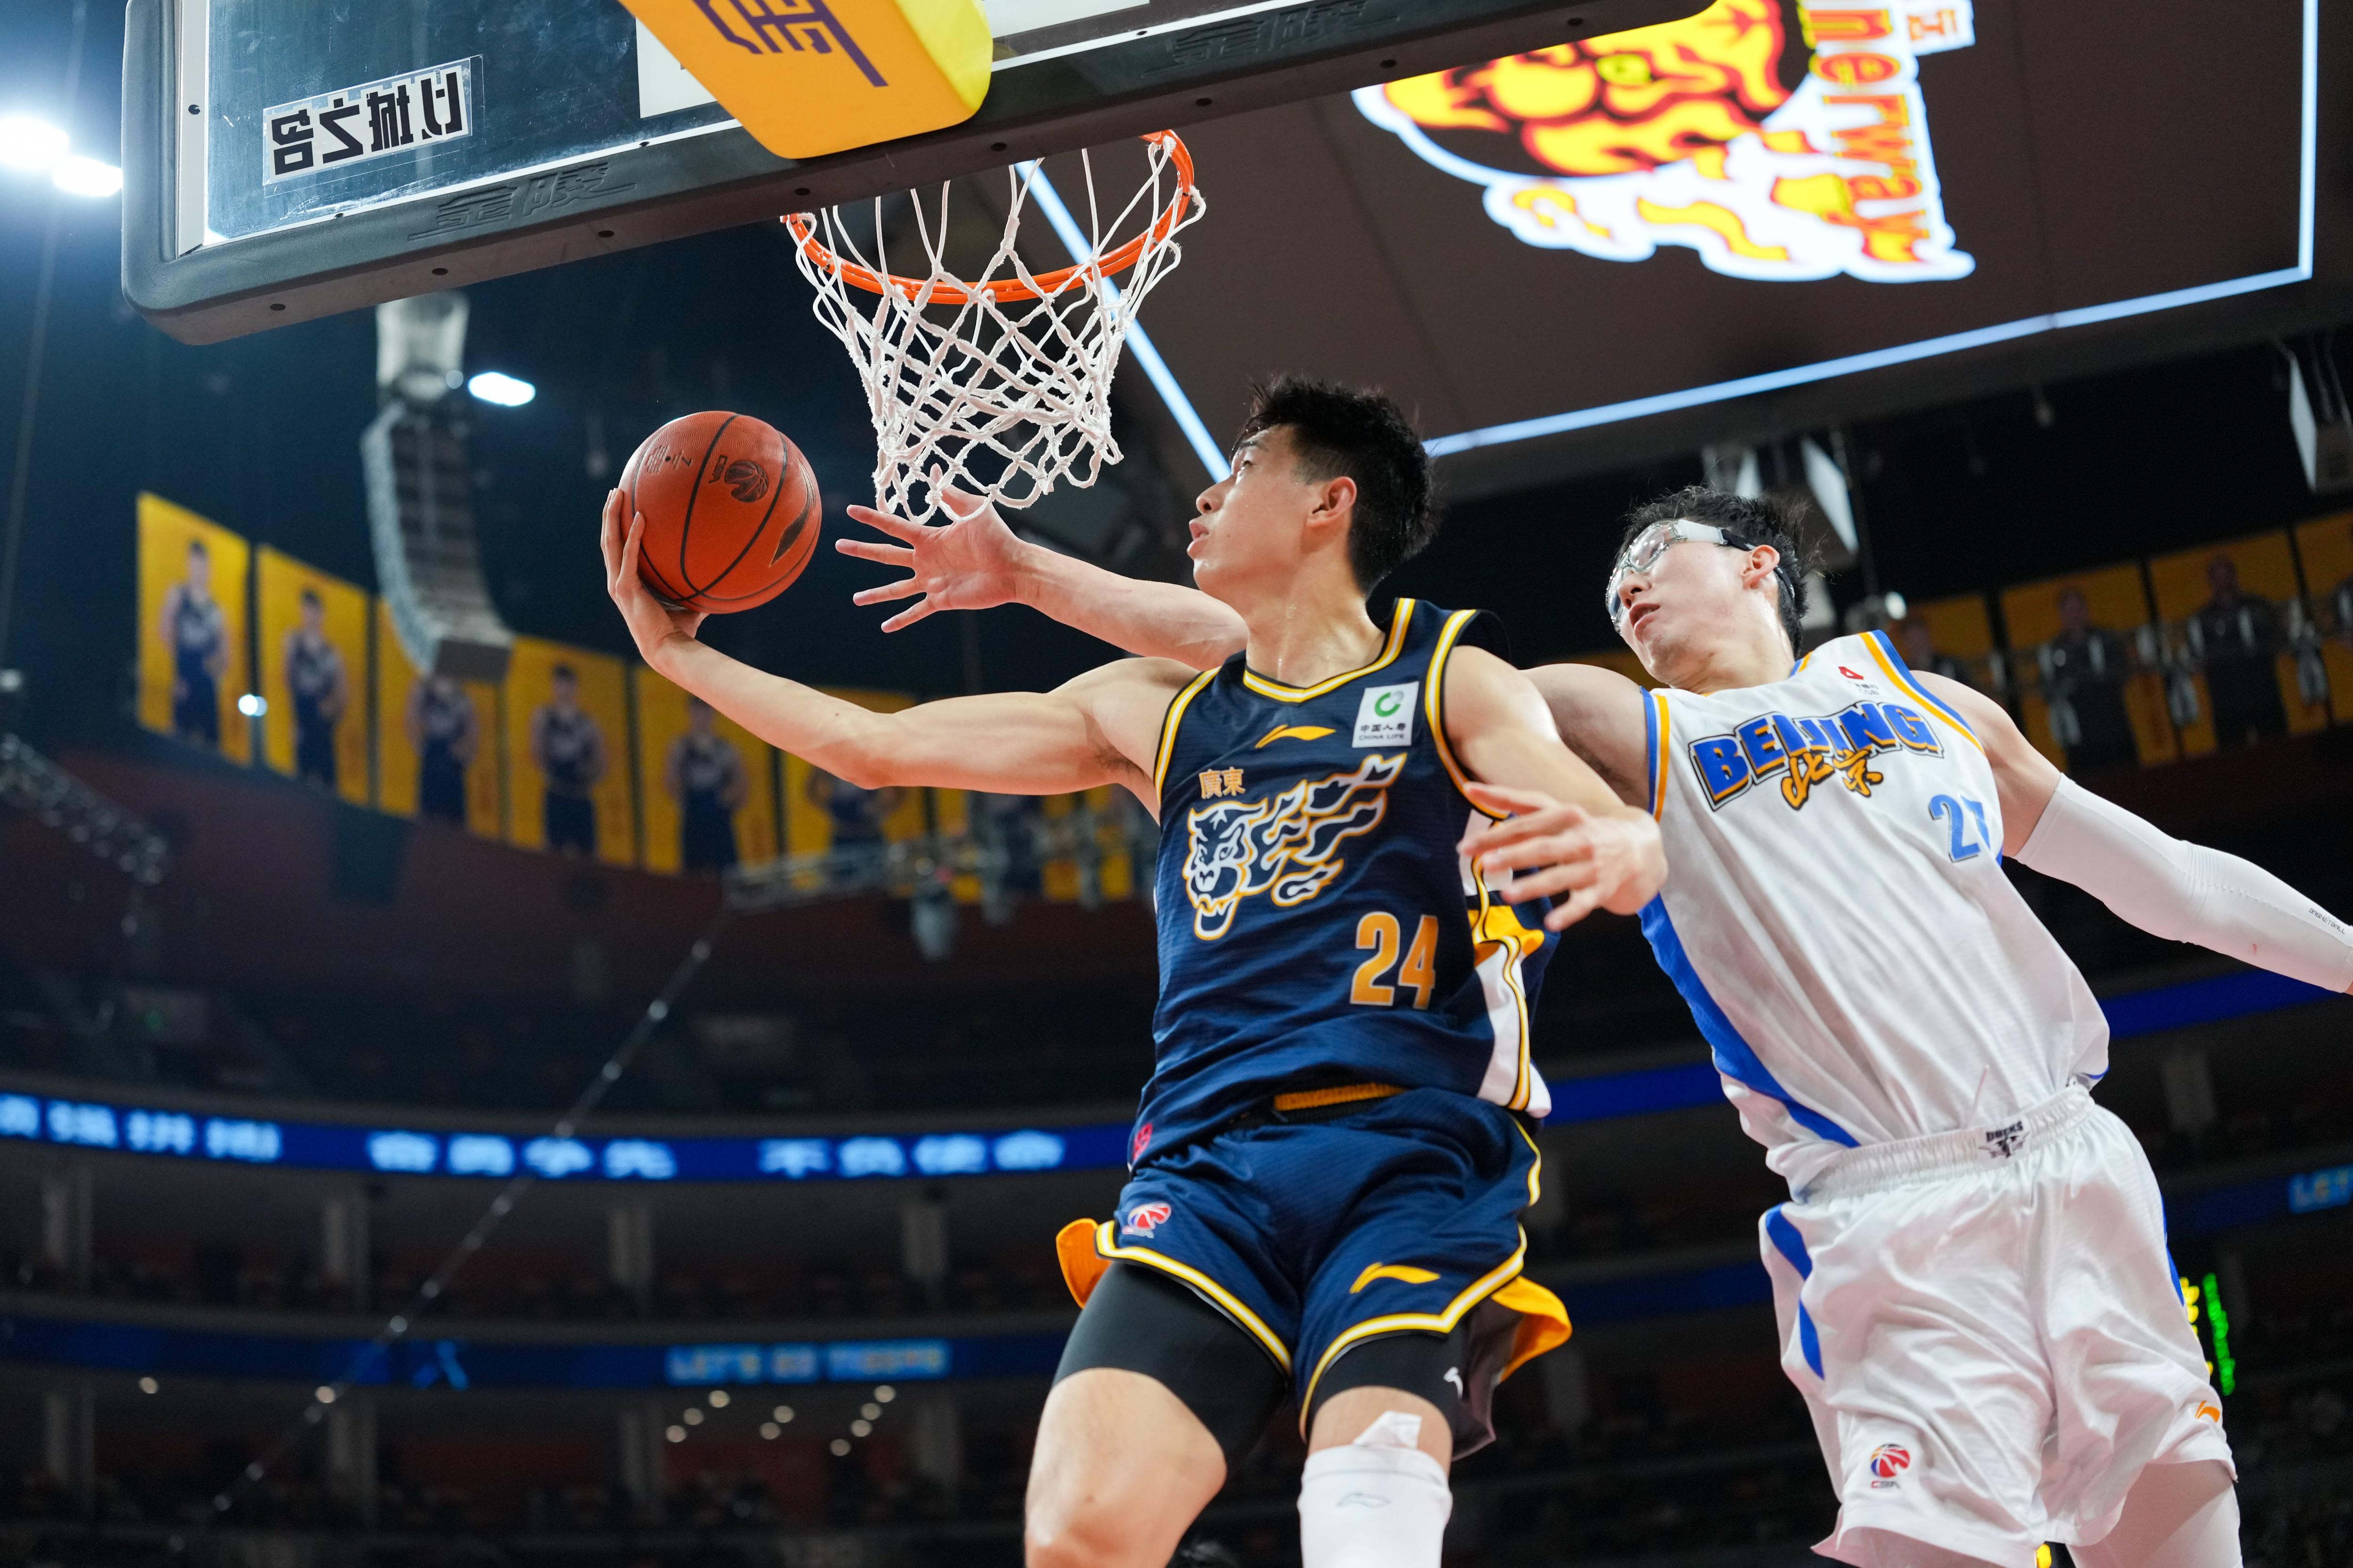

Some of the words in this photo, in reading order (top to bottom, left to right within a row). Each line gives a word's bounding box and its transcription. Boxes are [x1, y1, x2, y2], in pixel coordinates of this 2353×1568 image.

[1199, 766, 1246, 800] 廣東
[1689, 700, 1944, 811] BEIJING
[1781, 748, 1883, 811] 北京
[2308, 907, 2345, 935] BASKETBALL
[1349, 911, 1439, 1010] 24
